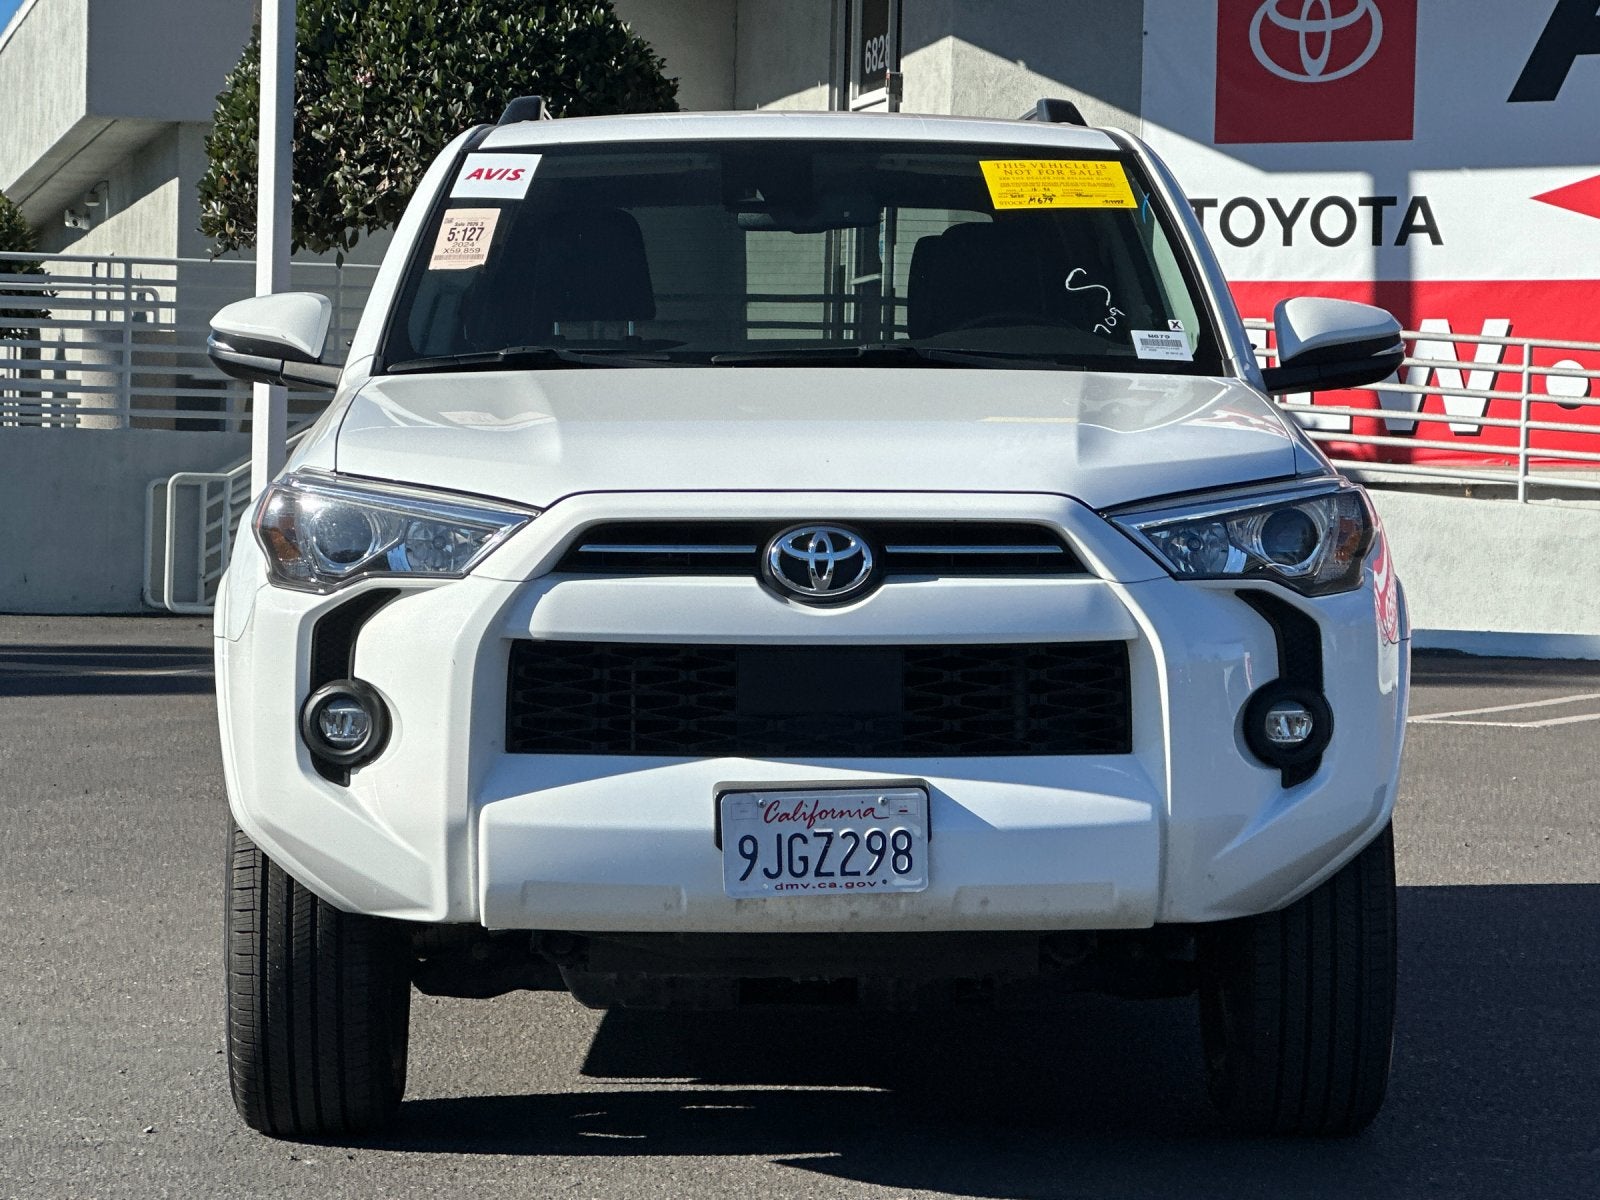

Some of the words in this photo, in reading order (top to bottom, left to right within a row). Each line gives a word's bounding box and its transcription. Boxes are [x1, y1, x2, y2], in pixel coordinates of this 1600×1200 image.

[464, 168, 526, 181] AVIS
[1187, 195, 1444, 248] TOYOTA
[447, 227, 485, 242] 5:127
[763, 799, 890, 829] California
[737, 828, 914, 882] 9JGZ298
[775, 880, 877, 892] dmv.ca.gov
